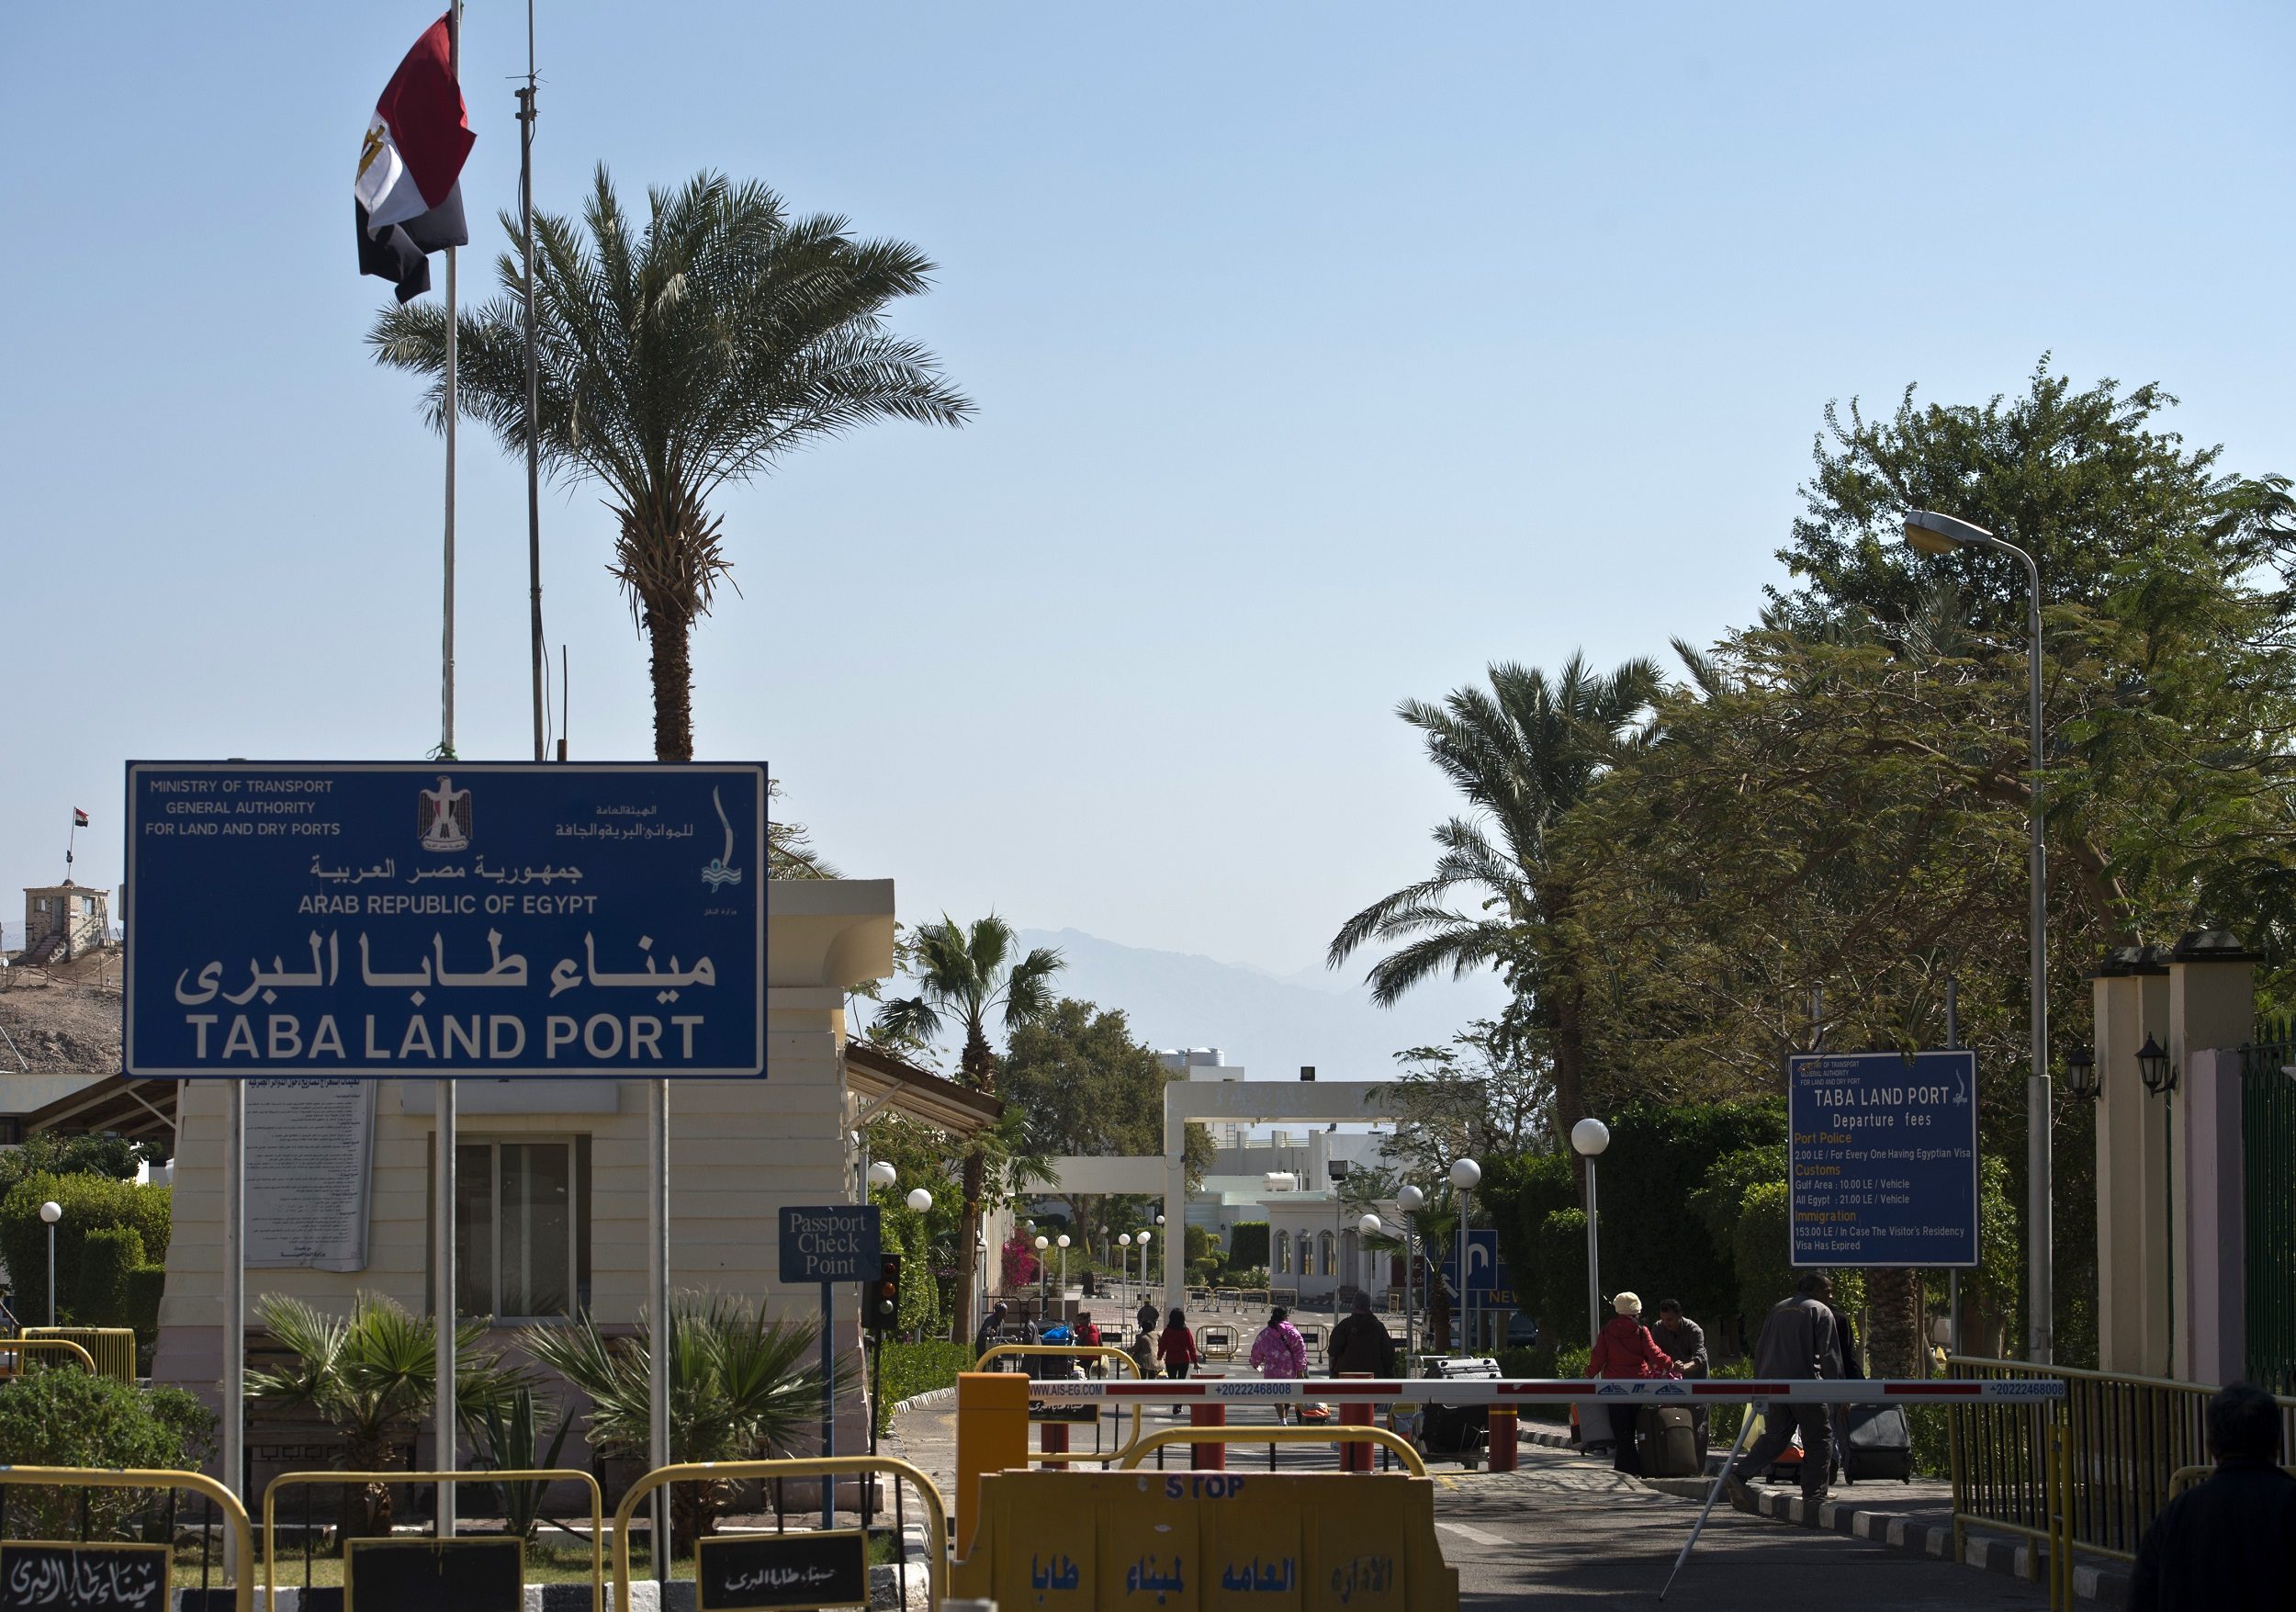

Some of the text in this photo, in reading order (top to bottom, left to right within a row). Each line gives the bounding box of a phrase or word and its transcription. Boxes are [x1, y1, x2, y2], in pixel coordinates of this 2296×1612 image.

[149, 780, 333, 794] MINISTRY OF TRANSPORT
[166, 801, 316, 815] GENERAL AUTHORITY
[145, 822, 341, 836] FOR LAND AND DRY PORTS
[310, 854, 584, 885] جمهورية مصر العربية
[298, 895, 598, 915] ARAB REPUBLIC OF EGYPT
[358, 927, 528, 1008] طابا
[549, 930, 716, 1004] ميناء
[186, 1014, 704, 1059] TABA LAND PORT
[1814, 1086, 1950, 1107] TABA LAND PORT
[1833, 1110, 1931, 1130] Departure fees
[1794, 1132, 1852, 1144] Port Police
[1795, 1150, 1812, 1160] 2.00
[1814, 1150, 1823, 1160] LE
[1830, 1149, 1843, 1160] For
[1845, 1149, 1868, 1162] Every
[1871, 1149, 1886, 1159] One
[1887, 1148, 1915, 1162] Having
[1917, 1148, 1952, 1161] Egyptian
[1953, 1147, 1971, 1158] Visa
[1795, 1164, 1841, 1176] Customs
[1795, 1179, 1812, 1189] Gulf
[1814, 1179, 1833, 1189] Area
[1840, 1179, 1861, 1189] 10.00
[1863, 1179, 1873, 1189] LE
[1880, 1178, 1910, 1189] Vehicle
[1795, 1195, 1806, 1205] All
[1807, 1195, 1830, 1207] Egypt
[1840, 1195, 1861, 1205] 21.00
[1863, 1195, 1873, 1204] LE
[1880, 1194, 1910, 1204] Vehicle
[789, 1212, 867, 1236] Passport
[1795, 1210, 1857, 1224] Immigration
[1795, 1227, 1821, 1236] 153.00
[1823, 1227, 1833, 1236] LE
[1840, 1226, 1847, 1236] In
[1849, 1226, 1870, 1236] Case
[1872, 1226, 1886, 1236] The
[1889, 1226, 1920, 1236] Visitor's
[1922, 1226, 1964, 1238] Residency
[797, 1232, 861, 1254] Check
[1795, 1240, 1861, 1253] Visa Has Expired
[805, 1255, 856, 1275] Point
[1215, 1382, 1292, 1395] +20222468008
[1165, 1474, 1246, 1500] STOP
[1030, 1551, 1081, 1603] طابا
